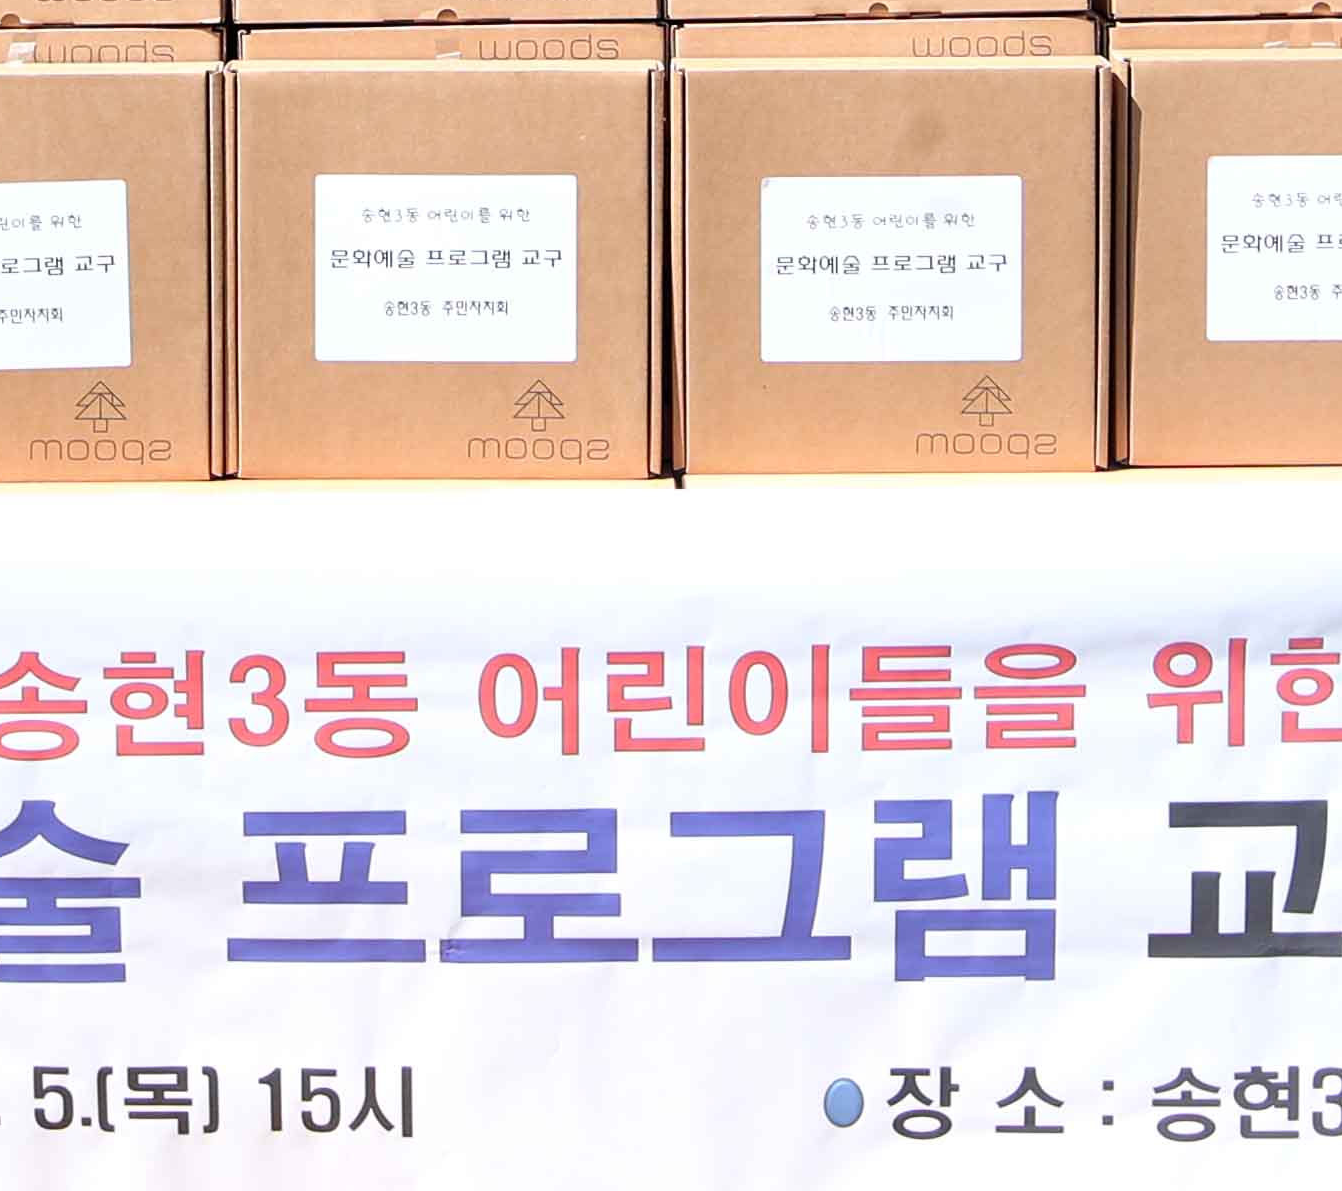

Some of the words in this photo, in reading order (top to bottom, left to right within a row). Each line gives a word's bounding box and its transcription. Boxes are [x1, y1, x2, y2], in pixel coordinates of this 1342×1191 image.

[478, 36, 618, 60] woods
[911, 32, 1052, 57] woods
[1251, 192, 1309, 208] 송현3동
[50, 214, 83, 229] 위한
[361, 207, 419, 224] 송현3동
[427, 207, 491, 224] 어린이를
[499, 208, 530, 223] 위한
[807, 213, 865, 230] 송현3동
[872, 212, 938, 230] 어린이를
[943, 212, 975, 228] 위한
[1221, 233, 1305, 254] 문화예술
[75, 254, 115, 274] 교구
[330, 249, 415, 269] 문화예술
[425, 249, 511, 269] 프로그램
[521, 249, 562, 268] 교구
[776, 255, 860, 275] 문화예술
[873, 254, 956, 274] 프로그램
[967, 254, 1007, 272] 교구
[1273, 284, 1320, 301] 송현3동
[385, 300, 431, 317] 송현3동
[442, 300, 509, 316] 주민자치회
[830, 305, 876, 322] 송현3동
[889, 305, 954, 321] 주민자치회
[478, 643, 1087, 756] 어린이들을
[227, 790, 1059, 981] 프로그램
[32, 1066, 220, 1136] 5.(목)
[258, 1066, 414, 1139] 15시
[887, 1066, 960, 1141] 장
[995, 1067, 1062, 1134] 소
